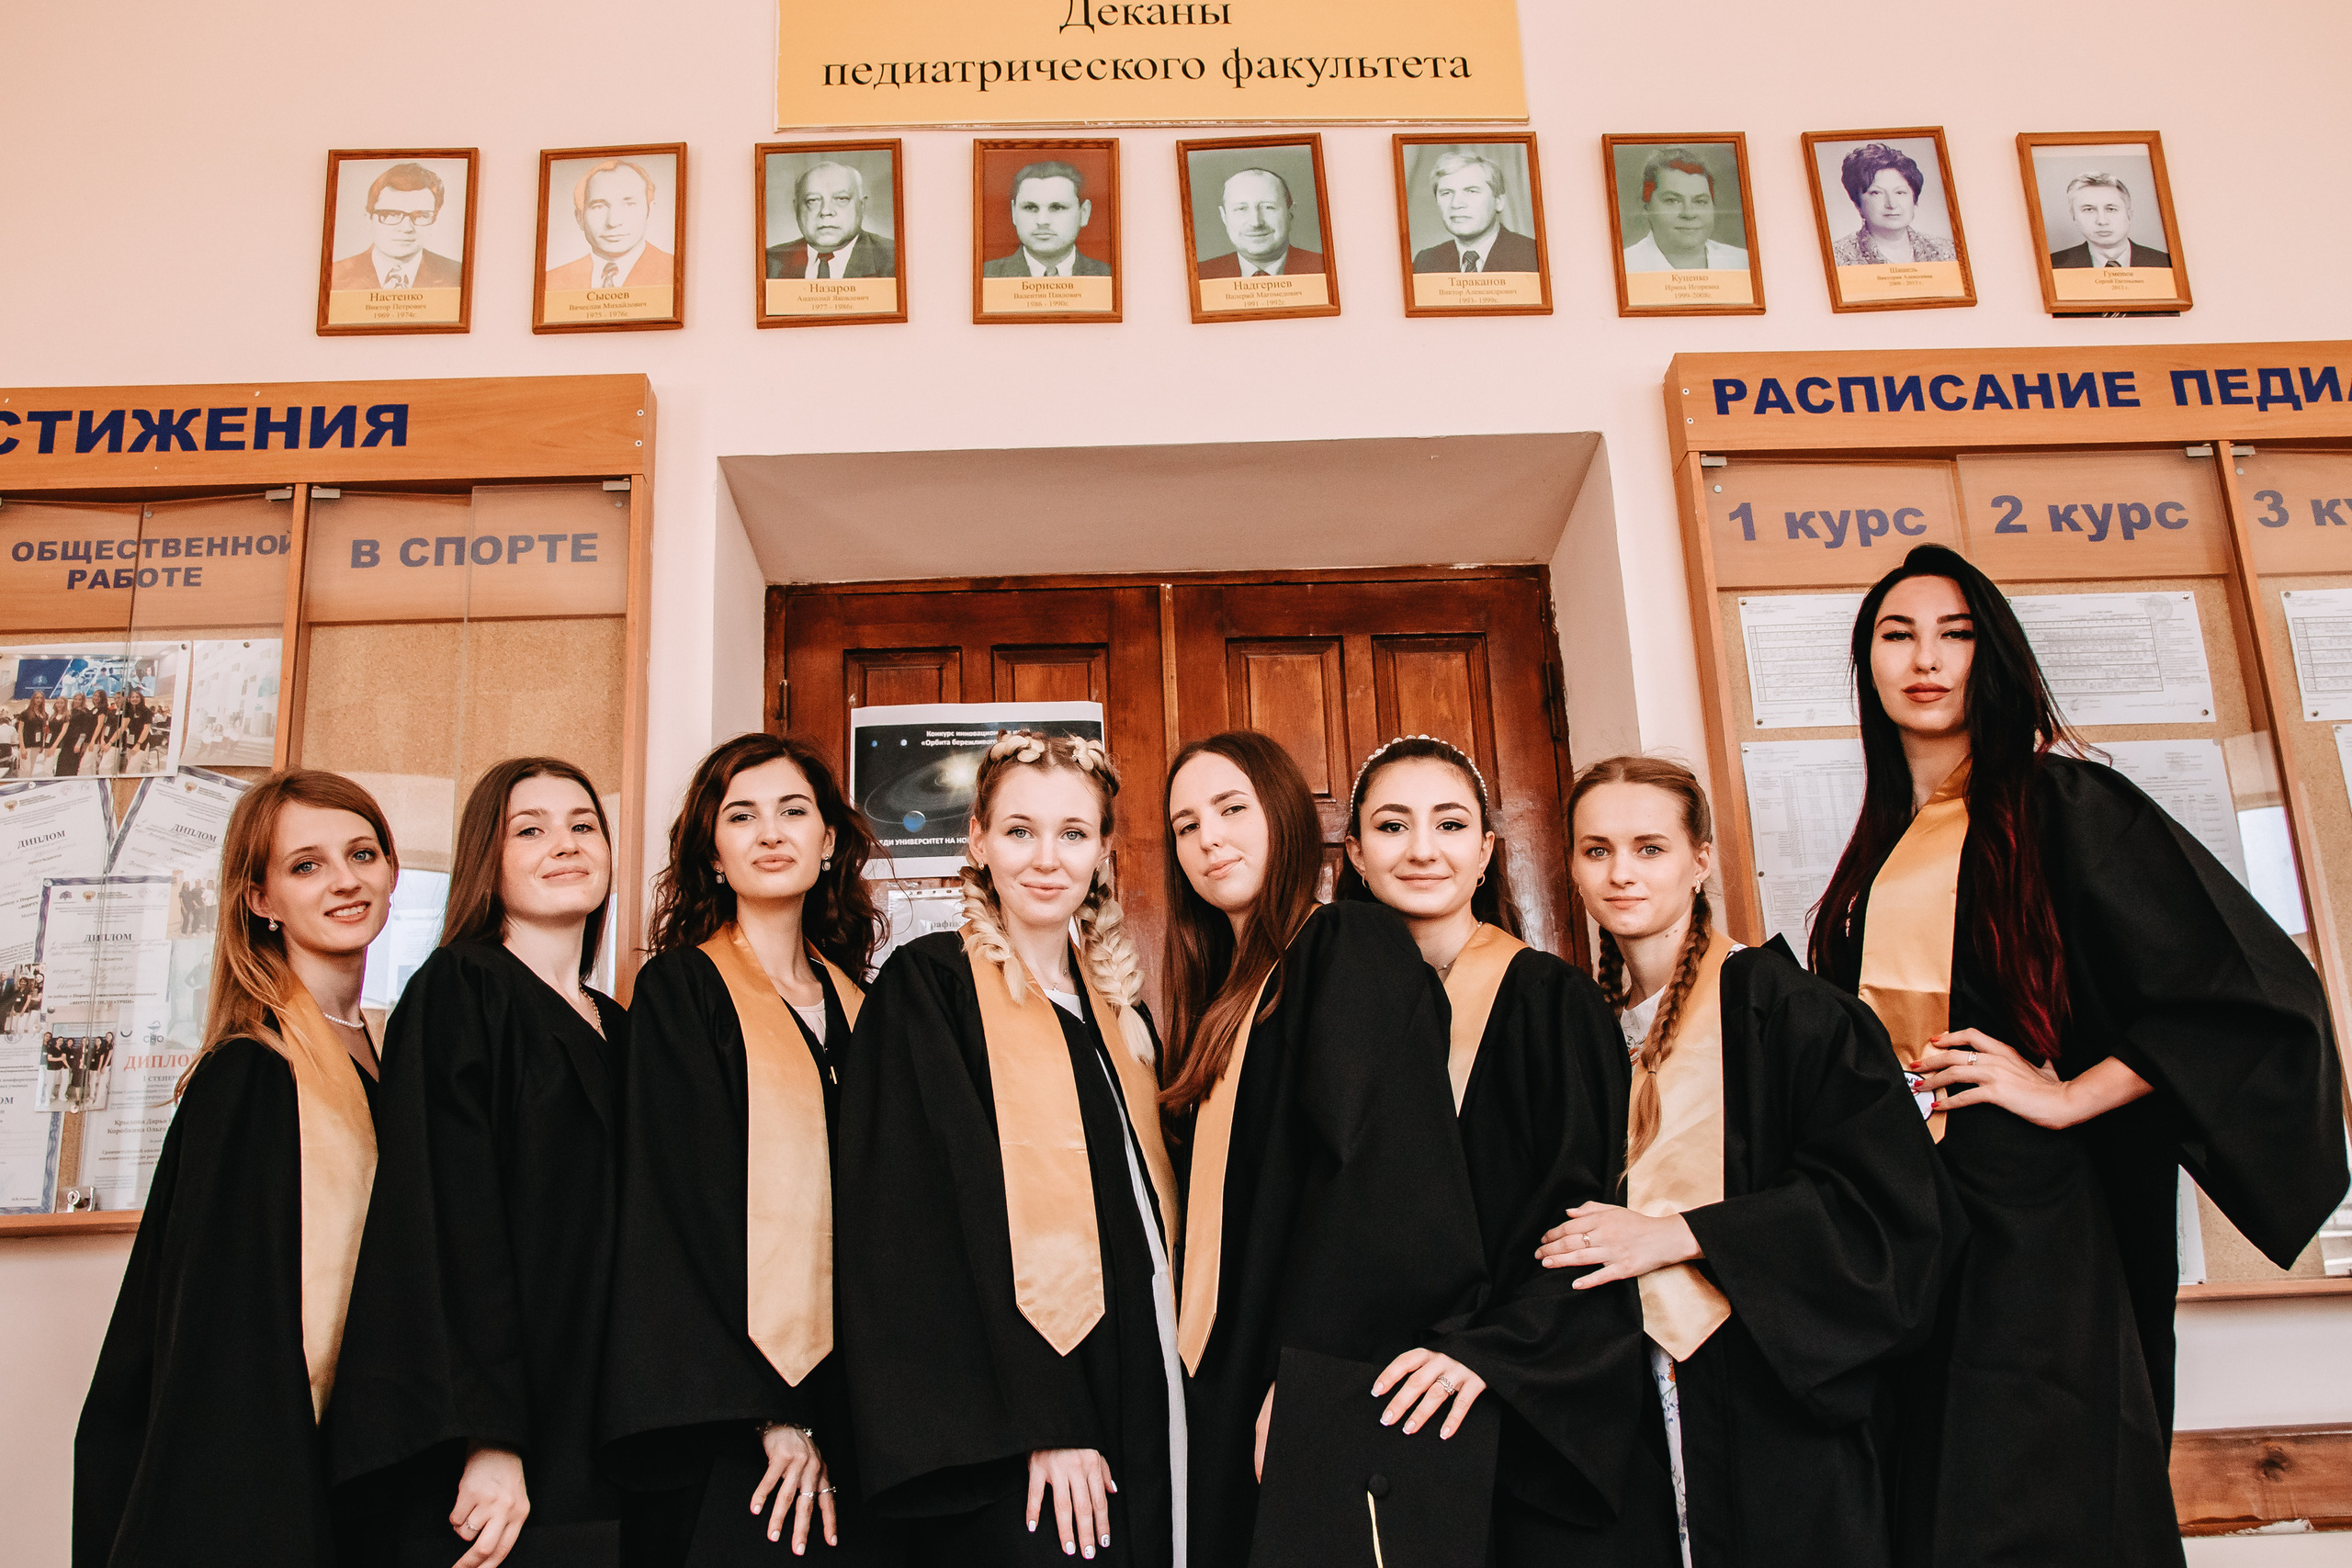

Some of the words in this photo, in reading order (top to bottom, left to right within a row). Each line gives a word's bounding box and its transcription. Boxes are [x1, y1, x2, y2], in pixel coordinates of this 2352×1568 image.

[1059, 0, 1232, 34] Деканы
[820, 56, 1205, 92] педиатрического
[1222, 47, 1472, 88] факультета
[810, 283, 856, 294] Назаров
[1022, 281, 1073, 292] Борисков
[1233, 280, 1292, 291] Надгериев
[1448, 277, 1507, 288] Тараканов
[370, 292, 423, 301] Настенко
[586, 291, 630, 301] Сысоев
[1713, 371, 2142, 415] РАСПИСАНИЕ
[2169, 366, 2352, 412] ПЕДИ
[2253, 490, 2290, 527] 3
[1729, 502, 1757, 541] 1
[1784, 507, 1928, 549] курс
[1990, 495, 2028, 533] 2
[2047, 502, 2188, 542] курс
[351, 539, 380, 569] В
[399, 533, 598, 568] СПОРТЕ
[66, 567, 203, 590] РАБОТЕ
[17, 830, 65, 849] ДИПЛОМ
[169, 824, 217, 843] ДИПЛОМ
[123, 1055, 197, 1072] ДИПЛО
